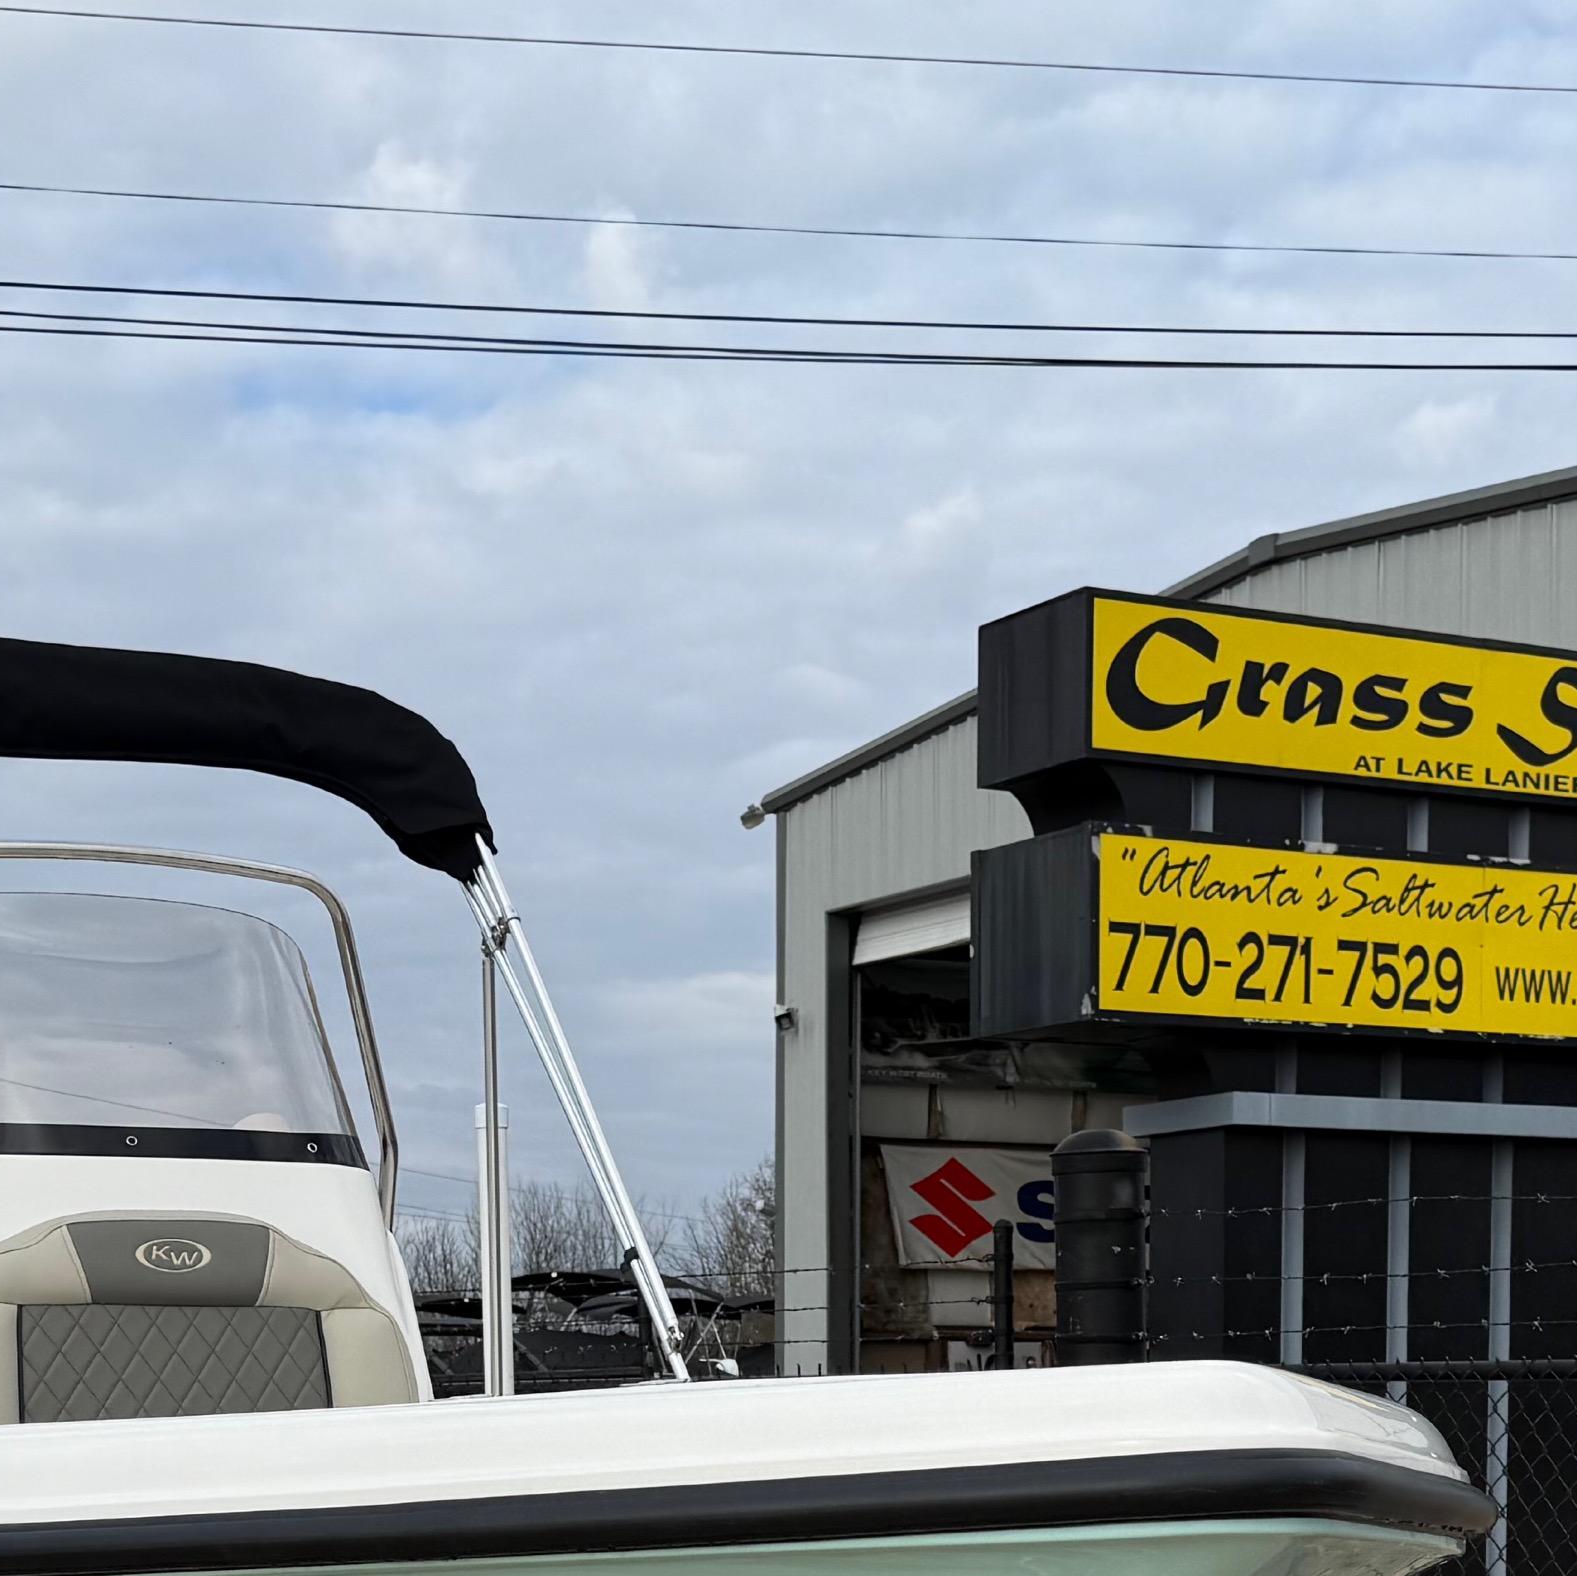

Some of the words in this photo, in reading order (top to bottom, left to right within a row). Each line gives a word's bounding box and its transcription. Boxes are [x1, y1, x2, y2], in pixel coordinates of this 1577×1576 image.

[1106, 617, 1474, 738] Grass
[1354, 756, 1385, 773] AT
[1397, 758, 1474, 782] LAKE
[1341, 866, 1533, 925] Saltwater
[1108, 918, 1464, 1014] 770-271-7529
[151, 1245, 199, 1266] KW
